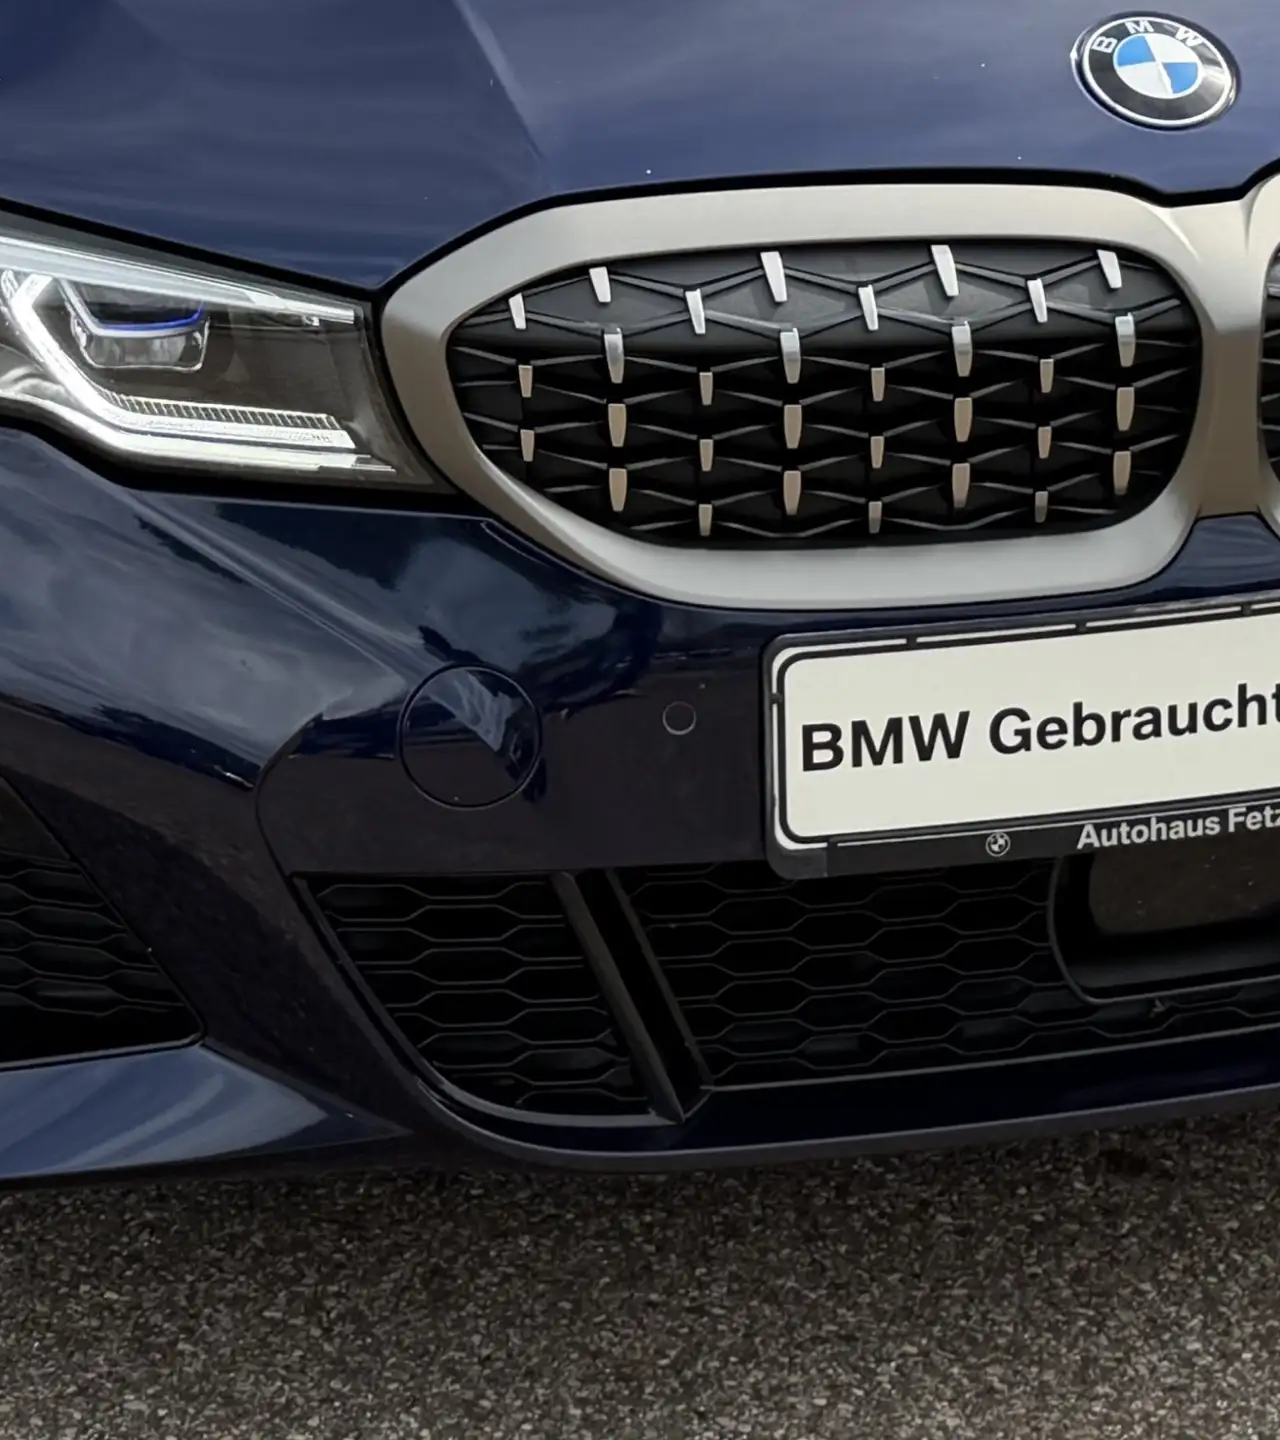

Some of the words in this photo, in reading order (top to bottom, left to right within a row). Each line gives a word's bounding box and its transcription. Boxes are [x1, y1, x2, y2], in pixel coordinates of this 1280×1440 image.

[1091, 19, 1204, 54] BMW
[801, 710, 971, 772] BMW
[1076, 815, 1221, 850] Autohaus
